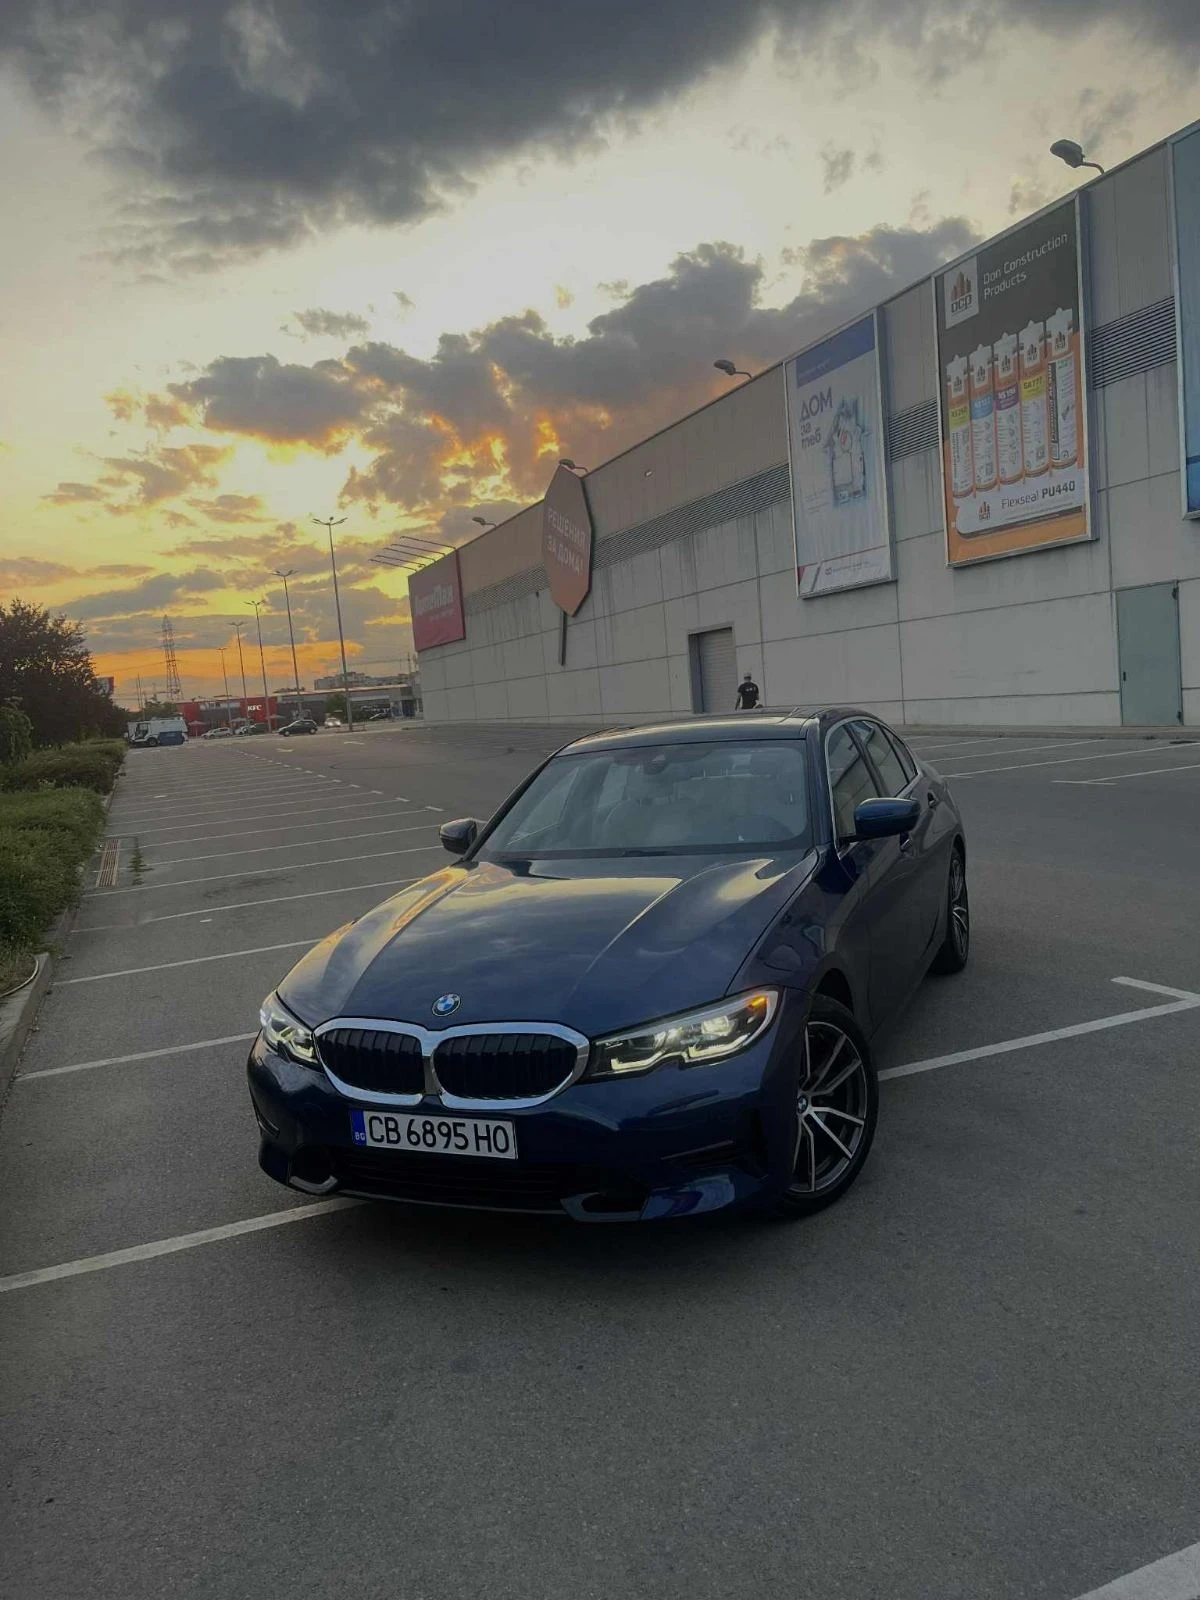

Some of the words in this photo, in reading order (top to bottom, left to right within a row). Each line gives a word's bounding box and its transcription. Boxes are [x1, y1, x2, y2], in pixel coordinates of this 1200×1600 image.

[983, 268, 1002, 285] Don
[1003, 233, 1068, 274] Construction
[983, 271, 1027, 301] Products
[800, 385, 833, 422] ДОМ
[1001, 490, 1039, 510] Flexseal
[1041, 480, 1076, 499] PU440
[368, 1115, 401, 1145] CB
[406, 1118, 469, 1150] 6895
[474, 1123, 510, 1154] HO
